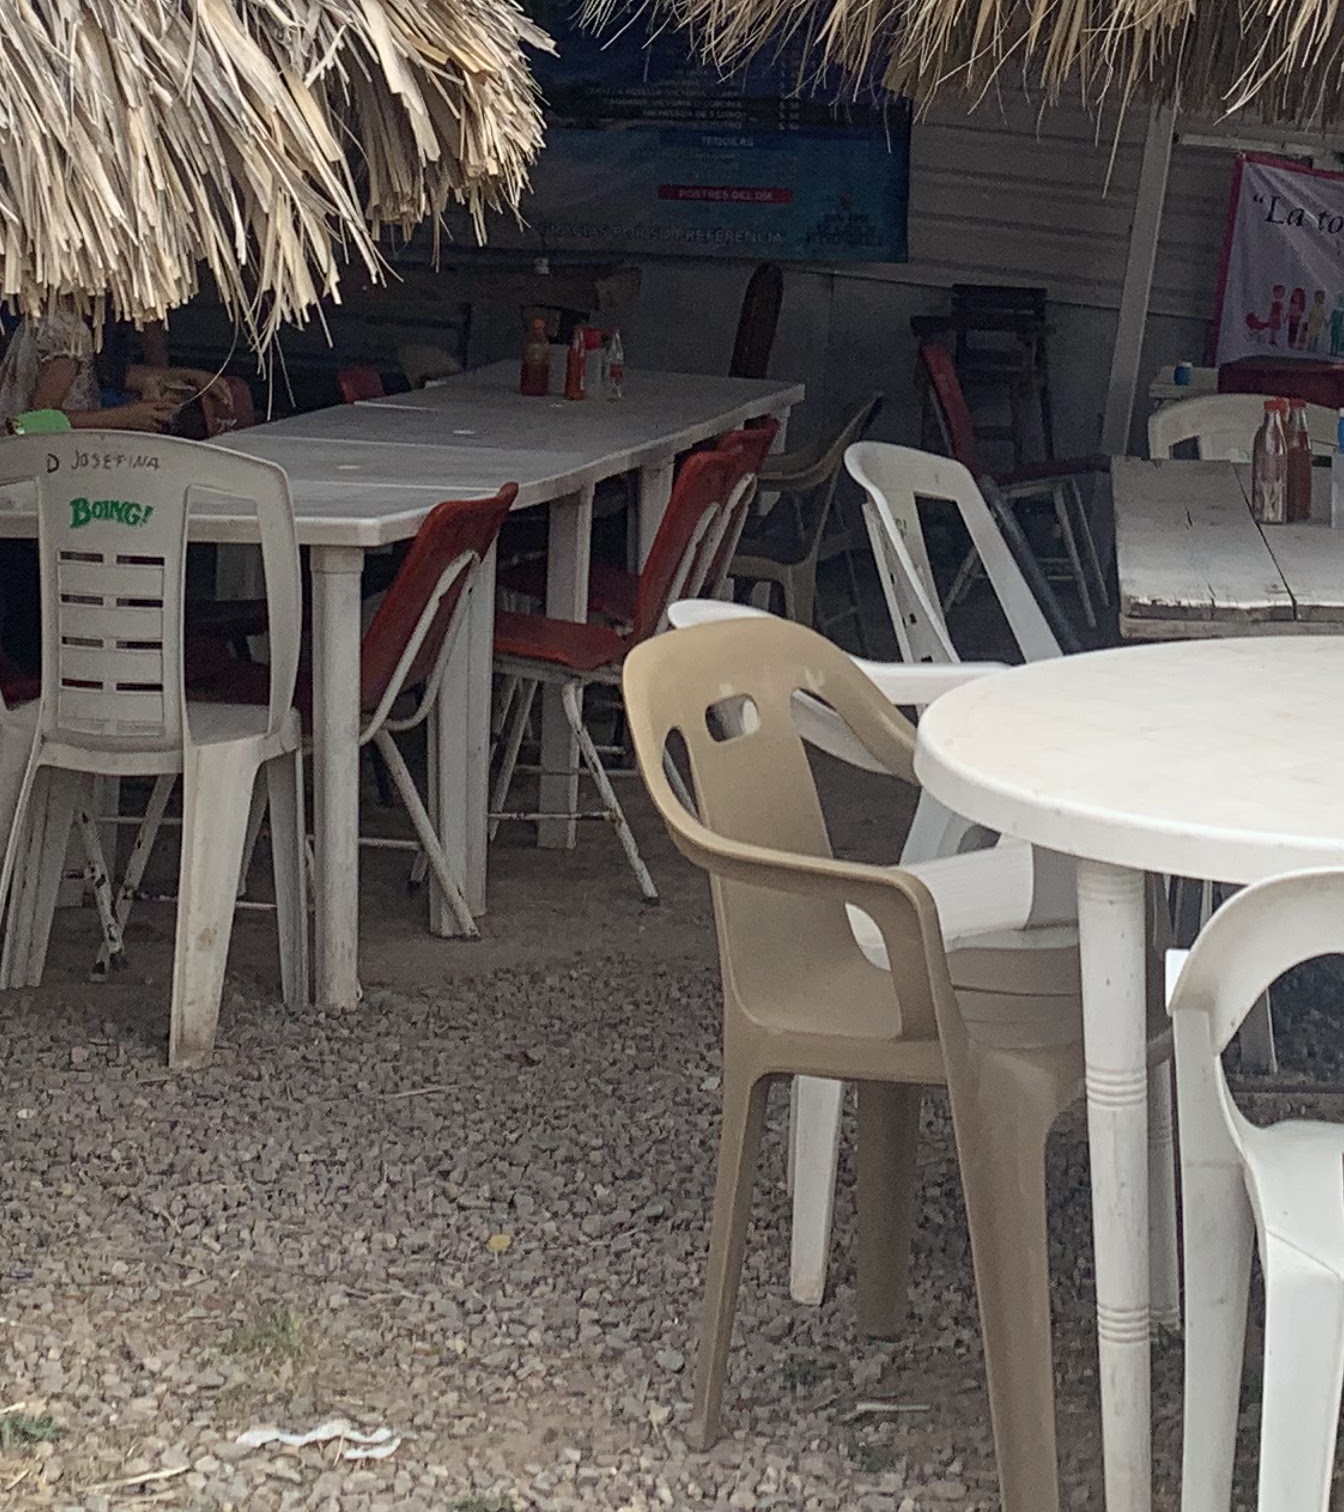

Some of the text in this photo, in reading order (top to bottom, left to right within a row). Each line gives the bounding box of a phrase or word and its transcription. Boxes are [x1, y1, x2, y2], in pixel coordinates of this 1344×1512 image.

[46, 449, 161, 474] D JOSEFINA
[69, 497, 155, 529] BOING!
